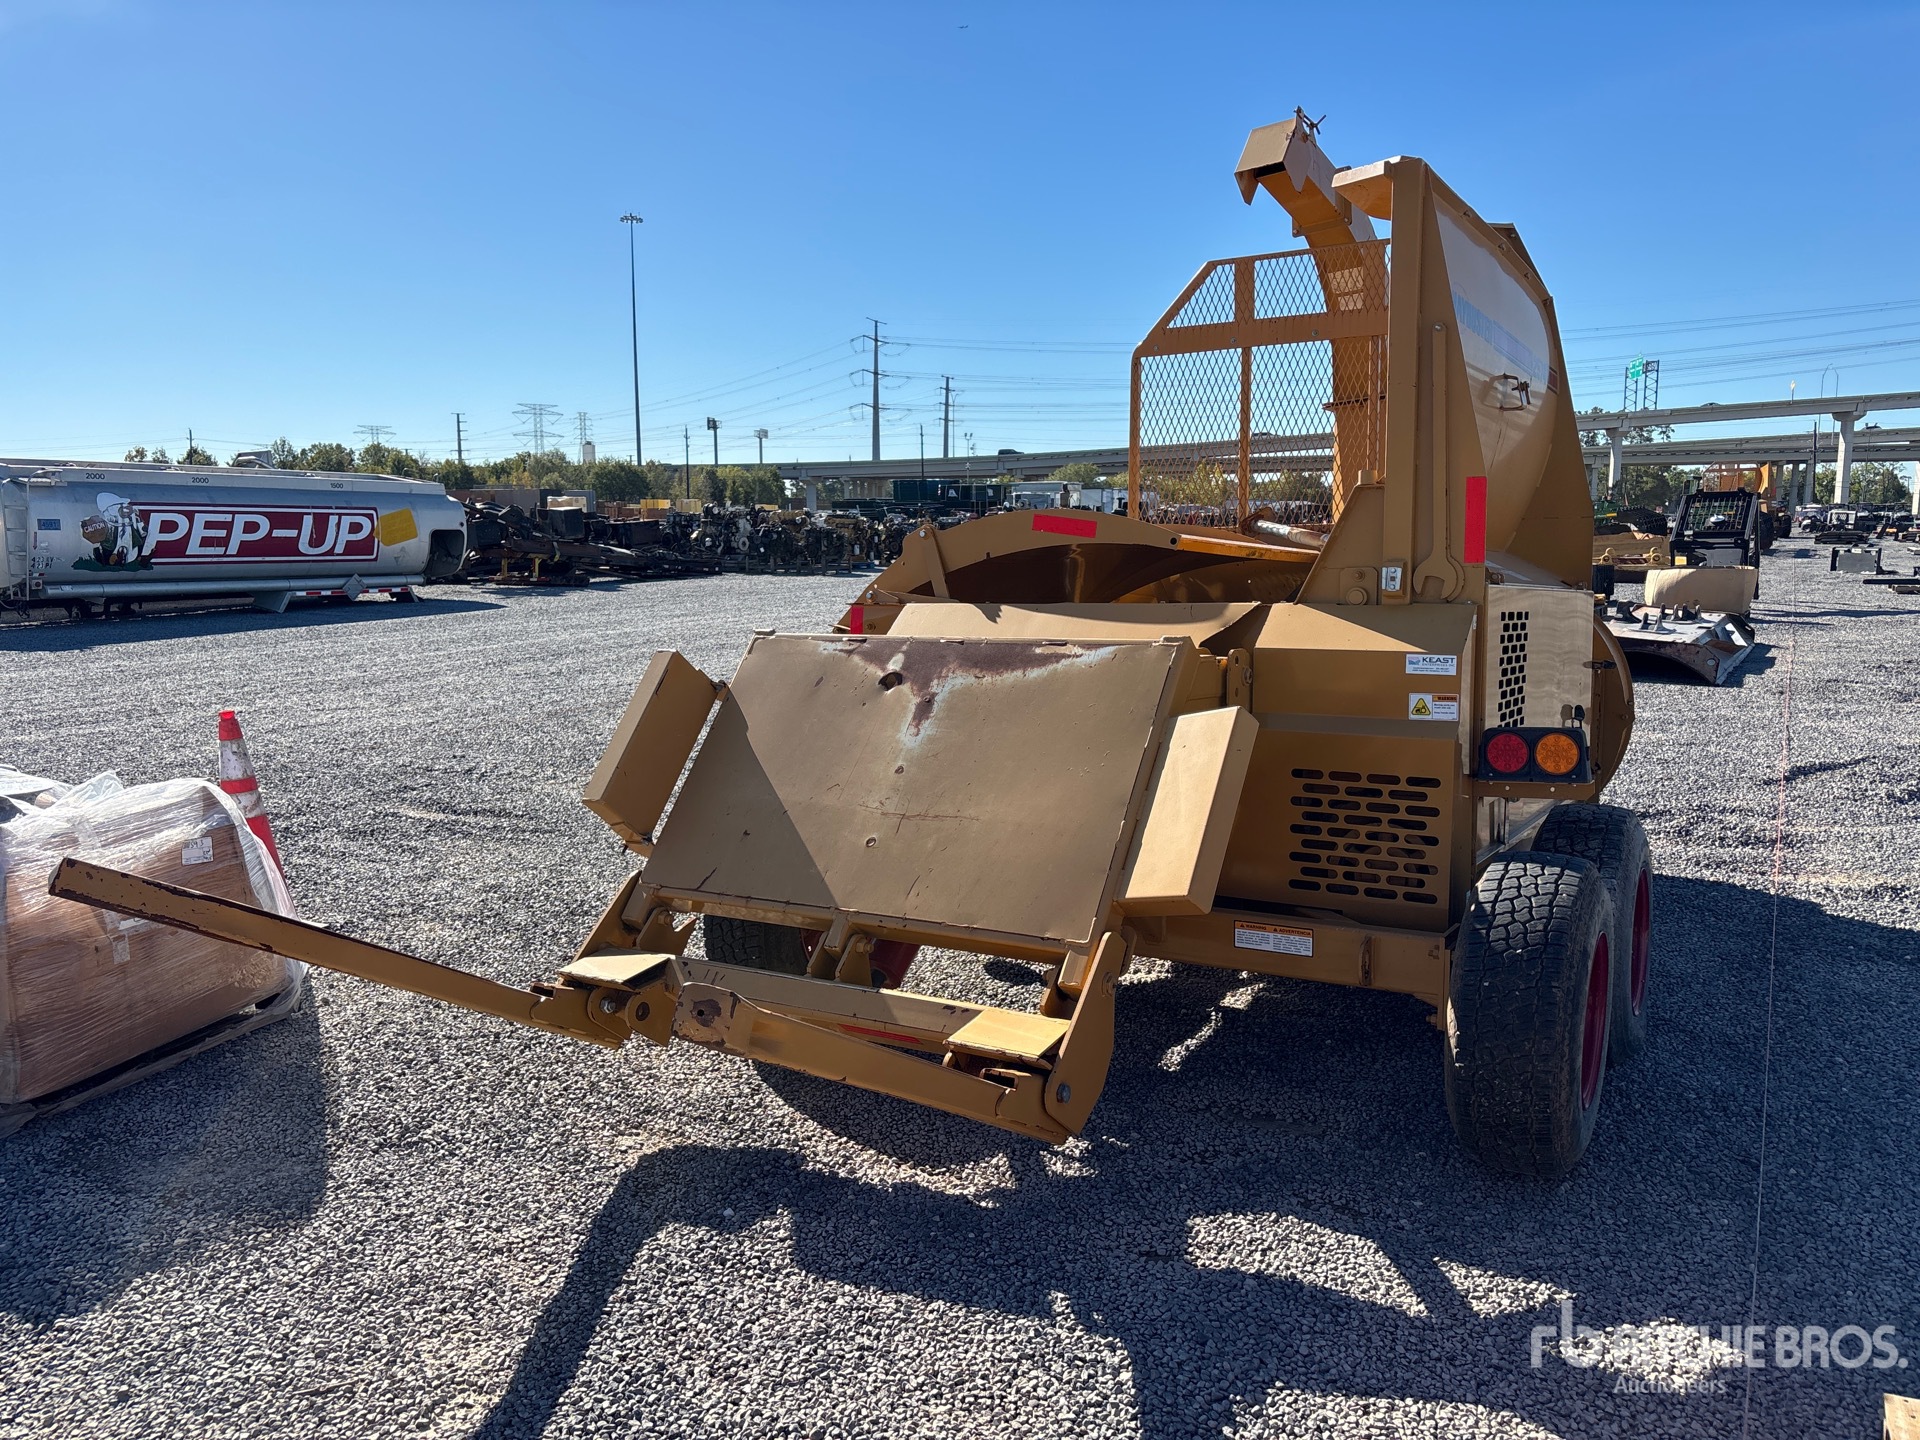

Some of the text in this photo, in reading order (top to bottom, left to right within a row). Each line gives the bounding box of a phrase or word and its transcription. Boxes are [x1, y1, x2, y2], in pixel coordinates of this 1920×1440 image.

[86, 472, 105, 480] 2000
[84, 522, 105, 533] CAUTION
[141, 512, 372, 556] PEP-UP
[1422, 656, 1456, 664] KEAST
